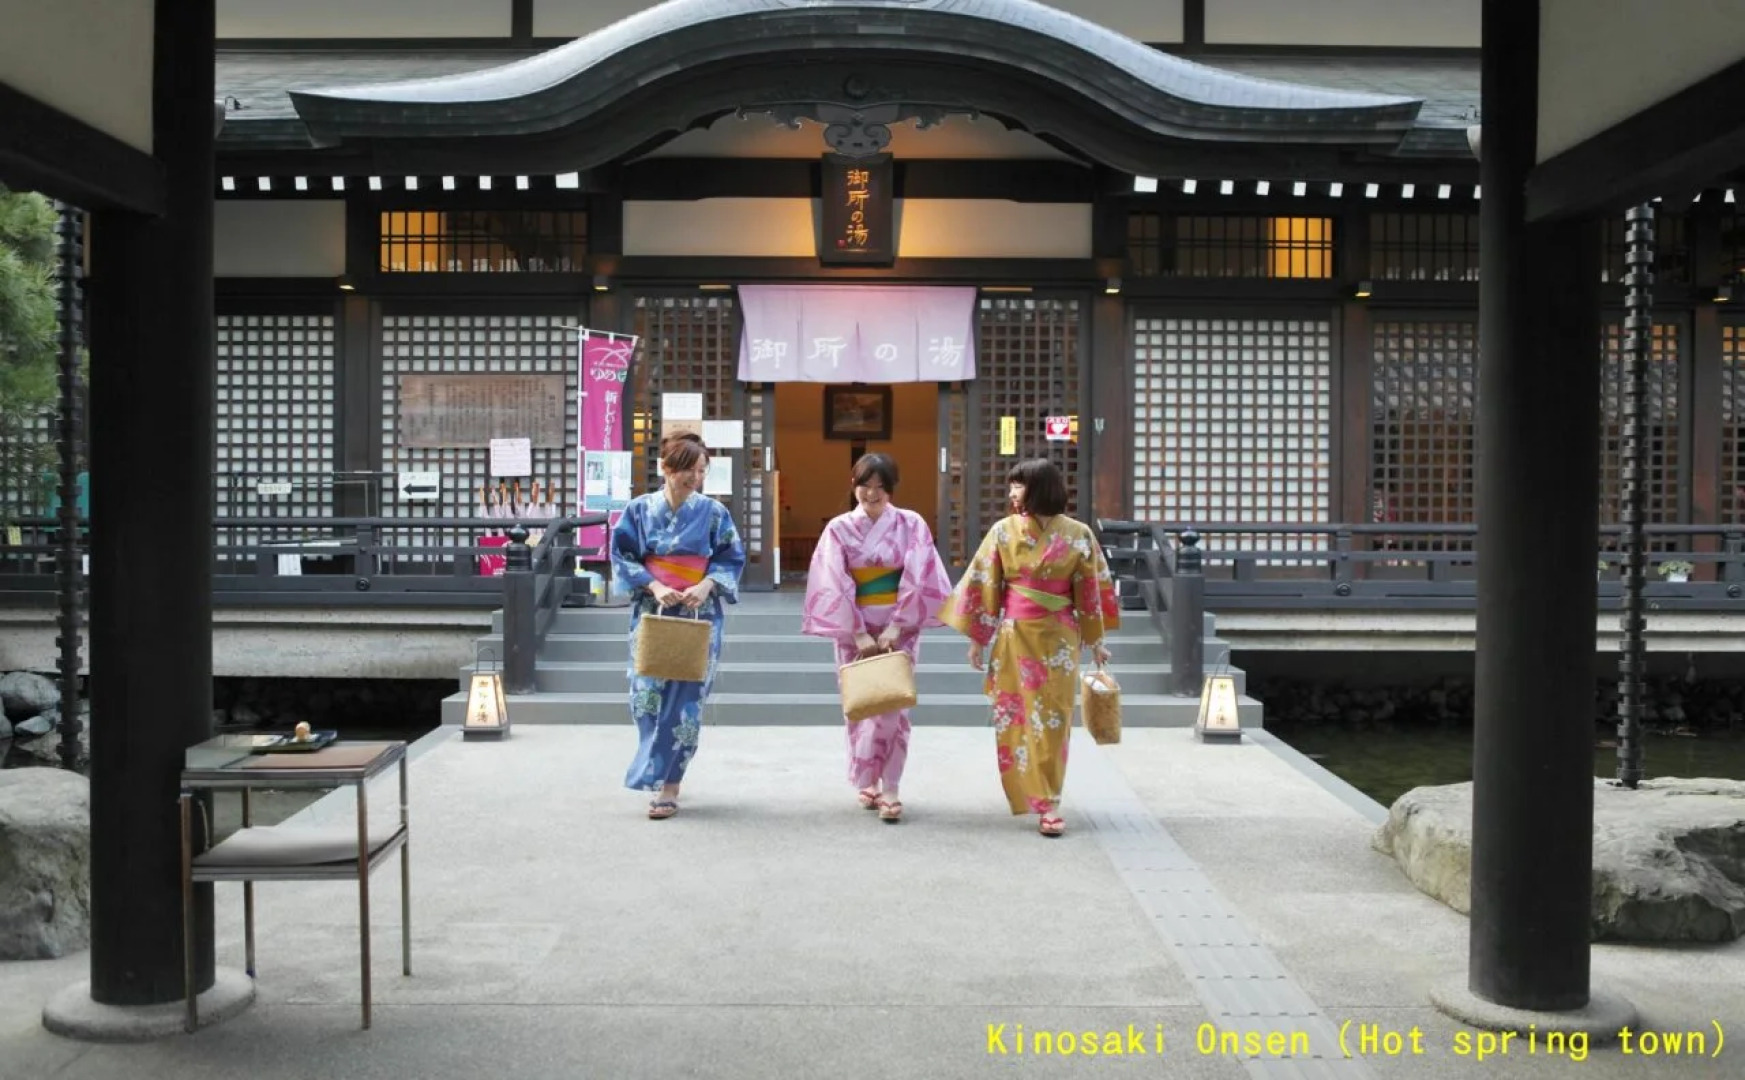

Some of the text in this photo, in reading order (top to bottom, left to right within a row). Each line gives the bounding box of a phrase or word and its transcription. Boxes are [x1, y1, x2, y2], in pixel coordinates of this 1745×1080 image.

[845, 169, 870, 246] 御所の湯
[750, 336, 965, 369] 御所の湯
